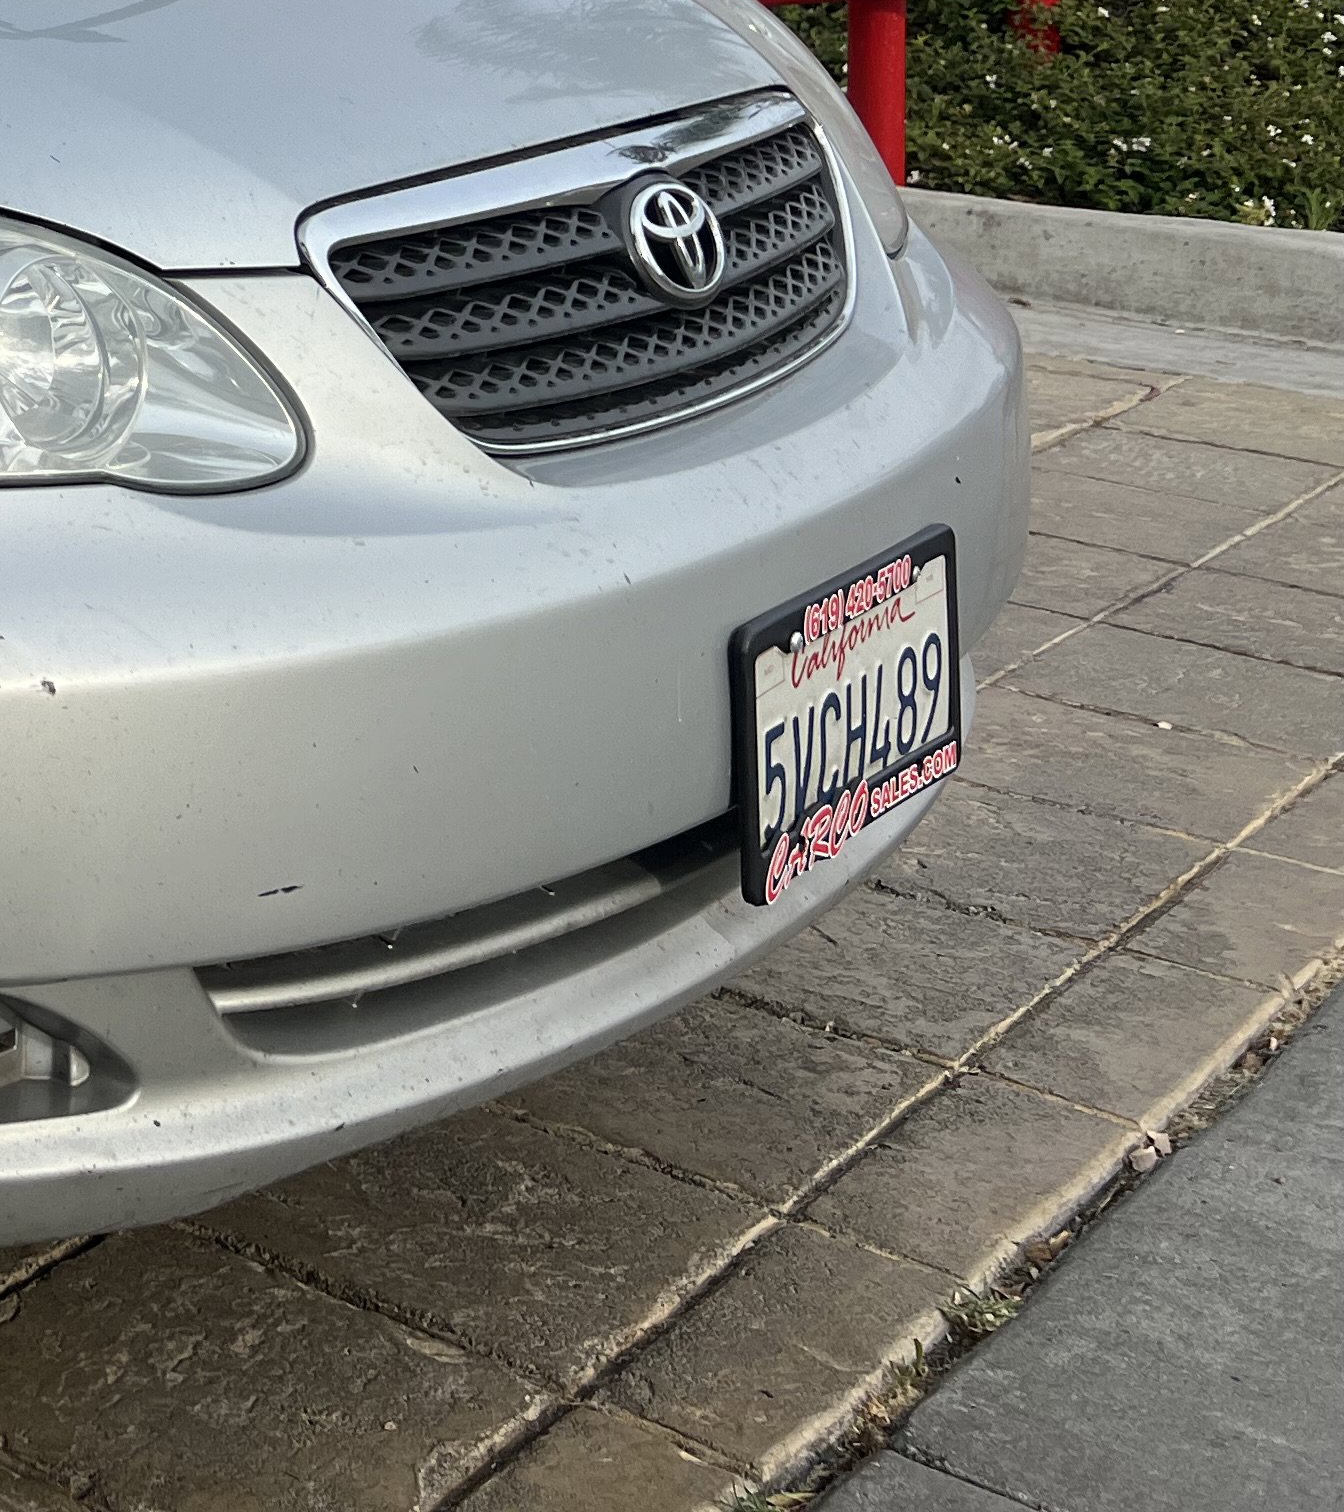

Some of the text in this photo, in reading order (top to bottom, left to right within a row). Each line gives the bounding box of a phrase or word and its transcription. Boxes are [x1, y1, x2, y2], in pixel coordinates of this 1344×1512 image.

[791, 597, 915, 688] California
[803, 554, 912, 646] (619) 420-5700
[762, 632, 943, 842] 5VCH489
[765, 740, 958, 905] CARCO SALES.COM
